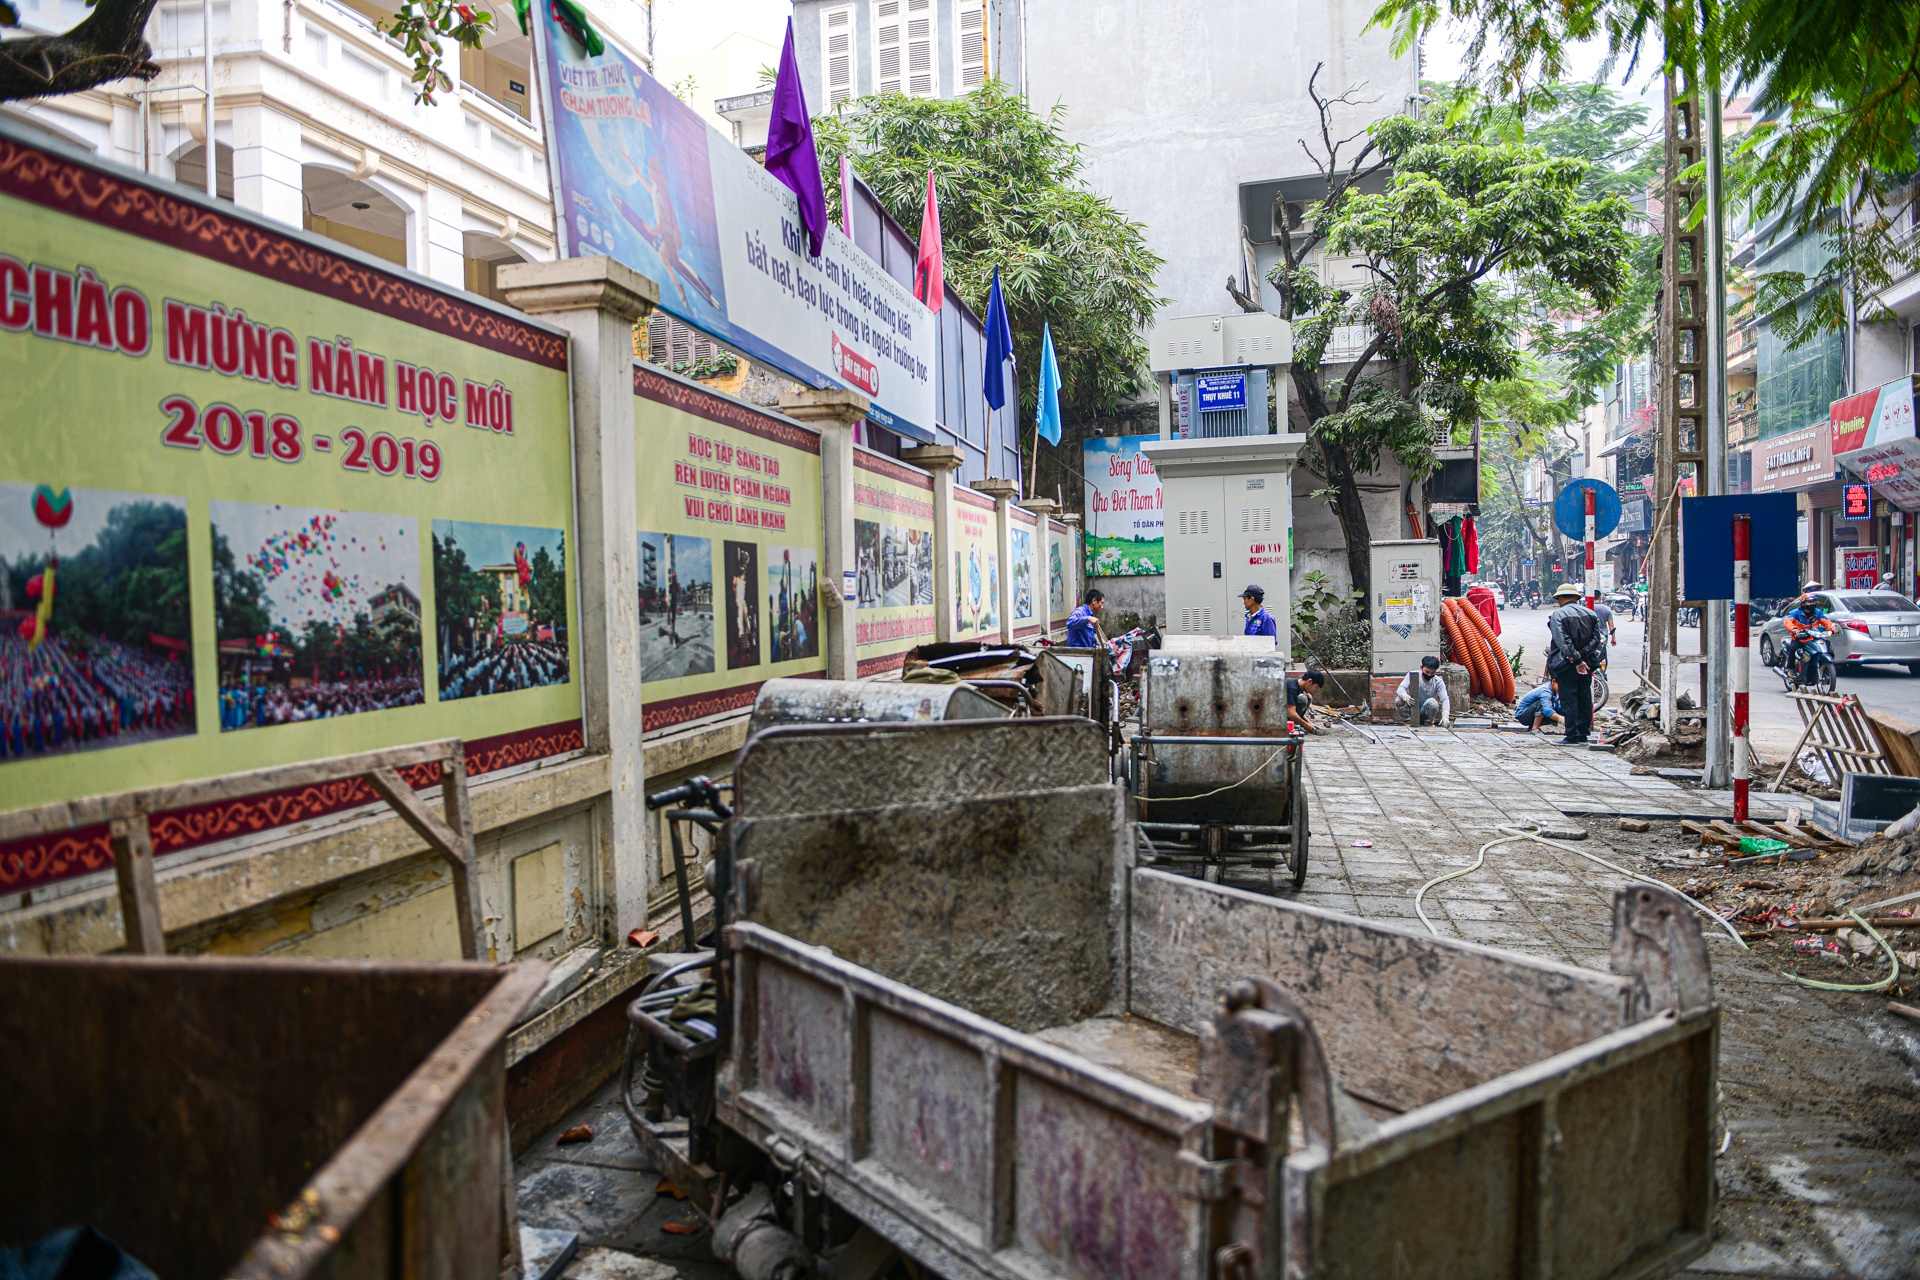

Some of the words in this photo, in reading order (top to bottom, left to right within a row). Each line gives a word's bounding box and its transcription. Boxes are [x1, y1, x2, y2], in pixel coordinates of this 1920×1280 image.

[747, 165, 759, 186] BỘ
[761, 177, 780, 201] GIÁO
[782, 192, 798, 215] DỤC
[781, 215, 801, 258] Khi
[825, 256, 840, 286] em
[842, 263, 851, 301] bị
[852, 272, 871, 313] hoặc
[873, 293, 896, 335] chứng
[897, 309, 912, 342] kiến
[745, 229, 769, 275] bắt
[772, 256, 796, 299] nạt,
[796, 267, 816, 309] bạo
[819, 282, 835, 322] lực
[836, 298, 859, 343] trong
[860, 317, 870, 345] và
[872, 328, 892, 361] ngoài
[893, 338, 915, 380] trường
[916, 355, 928, 386] học
[0, 254, 151, 358] CHÀO
[163, 297, 299, 390] MỪNG
[307, 335, 388, 409] NĂM
[395, 359, 458, 427] HỌC
[464, 378, 515, 436] MỚI
[1202, 393, 1217, 402] THỤY
[1217, 390, 1233, 401] KHUÊ
[1233, 391, 1240, 399] 11
[160, 394, 304, 464] 2018
[313, 435, 332, 452] -
[340, 426, 443, 482] 2019
[1840, 416, 1865, 436] Havoline
[689, 432, 712, 462] HỌC
[714, 439, 734, 468] TẬP
[736, 446, 761, 474] SÁNG
[762, 454, 780, 480] TẠO
[1109, 448, 1132, 482] Sống
[1134, 452, 1156, 475] Xan
[674, 459, 697, 488] RÈN
[699, 467, 731, 497] LUYỆN
[733, 475, 761, 501] CHĂM
[762, 482, 791, 507] NGOAN
[1092, 490, 1109, 513] Cho
[1111, 489, 1127, 512] Đời
[1128, 489, 1154, 511] Thơm
[1155, 487, 1164, 510] N
[684, 494, 705, 521] VUI
[707, 499, 733, 525] CHƠI
[735, 502, 759, 528] LÀNH
[761, 509, 786, 534] MẠNH
[1133, 519, 1140, 529] TỔ
[1141, 519, 1154, 529] DÂN
[1155, 520, 1164, 528] PH
[1846, 554, 1859, 571] SỬA
[1859, 553, 1876, 570] CHỮA
[1850, 577, 1859, 589] XE
[1859, 574, 1873, 589] MÁY
